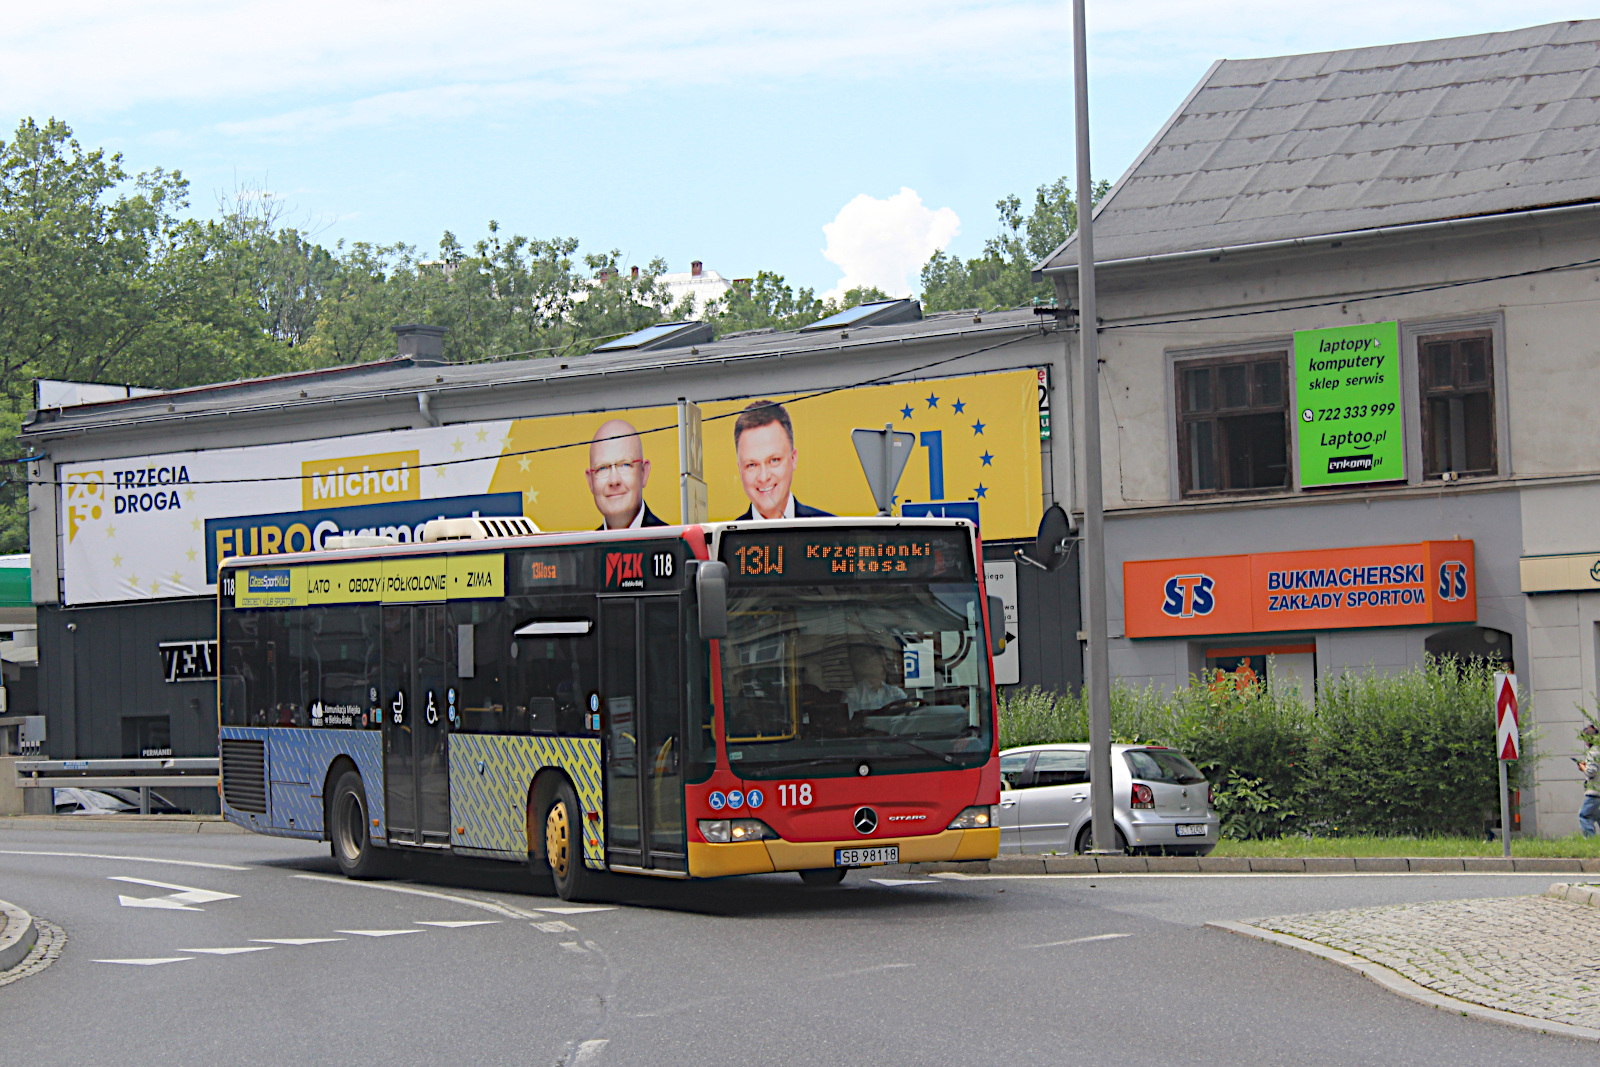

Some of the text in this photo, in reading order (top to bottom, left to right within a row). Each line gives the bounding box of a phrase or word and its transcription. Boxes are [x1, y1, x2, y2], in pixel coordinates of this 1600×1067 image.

[1319, 338, 1372, 354] laptopy
[1309, 355, 1385, 371] komputery
[1309, 372, 1384, 390] sklep serwis
[1318, 402, 1395, 422] 722 333 999
[1320, 430, 1387, 450] Laptoo.pl
[920, 430, 944, 500] 1
[1328, 457, 1383, 470] enkomp.pl
[113, 465, 190, 490] TRZECIA
[312, 461, 410, 500] Michał
[114, 491, 181, 514] DROGA
[735, 545, 783, 575] 13W
[806, 543, 930, 558] Krzemionki
[606, 552, 644, 588] MZK
[653, 553, 673, 577] 118
[832, 559, 907, 573] Witosa
[1267, 562, 1424, 590] BUKMACHERSKI
[223, 578, 236, 596] 118
[308, 579, 330, 594] LATO
[349, 578, 381, 593] OBOZY
[387, 574, 447, 592] PÓŁKOLONIE
[467, 572, 493, 588] ZIMA
[1438, 561, 1467, 602] STS
[1161, 573, 1215, 619] STS
[1268, 592, 1343, 612] ZAKŁADY
[778, 783, 813, 806] 118
[843, 850, 859, 863] SB
[862, 848, 897, 862] 98118
